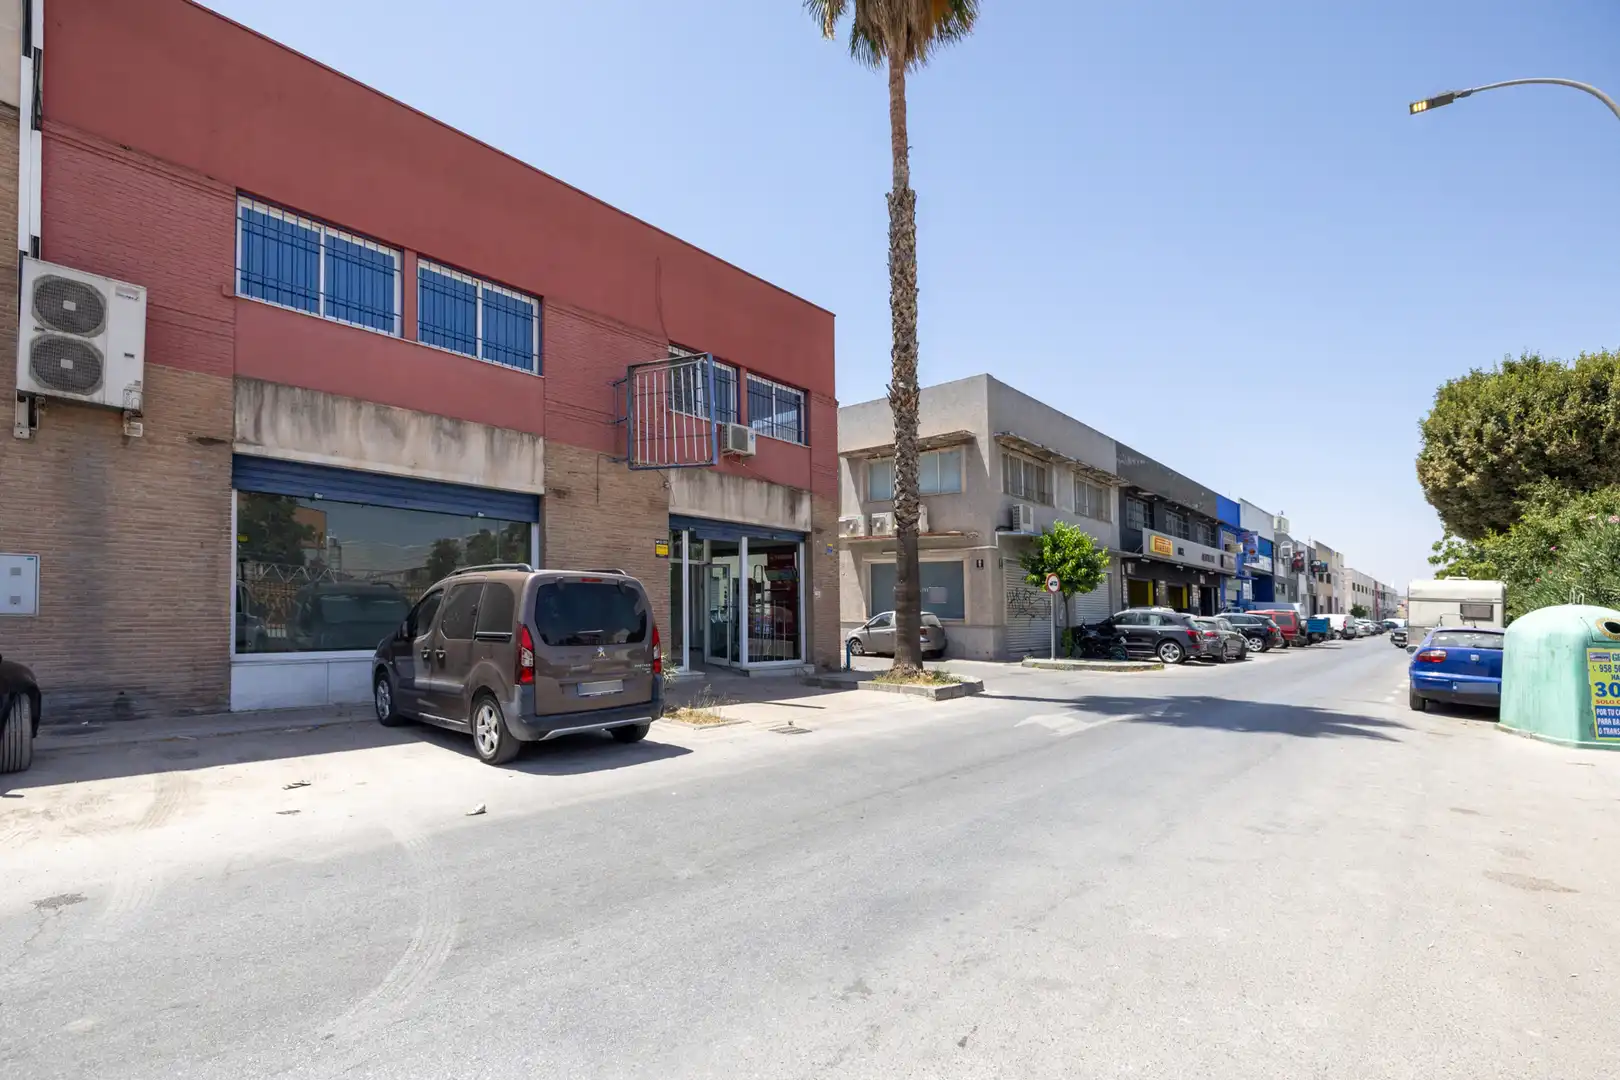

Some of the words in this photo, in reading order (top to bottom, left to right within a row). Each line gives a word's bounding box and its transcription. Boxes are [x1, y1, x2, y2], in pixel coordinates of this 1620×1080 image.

[1599, 664, 1612, 673] 958
[1596, 708, 1607, 716] POR
[1597, 717, 1612, 726] PARA
